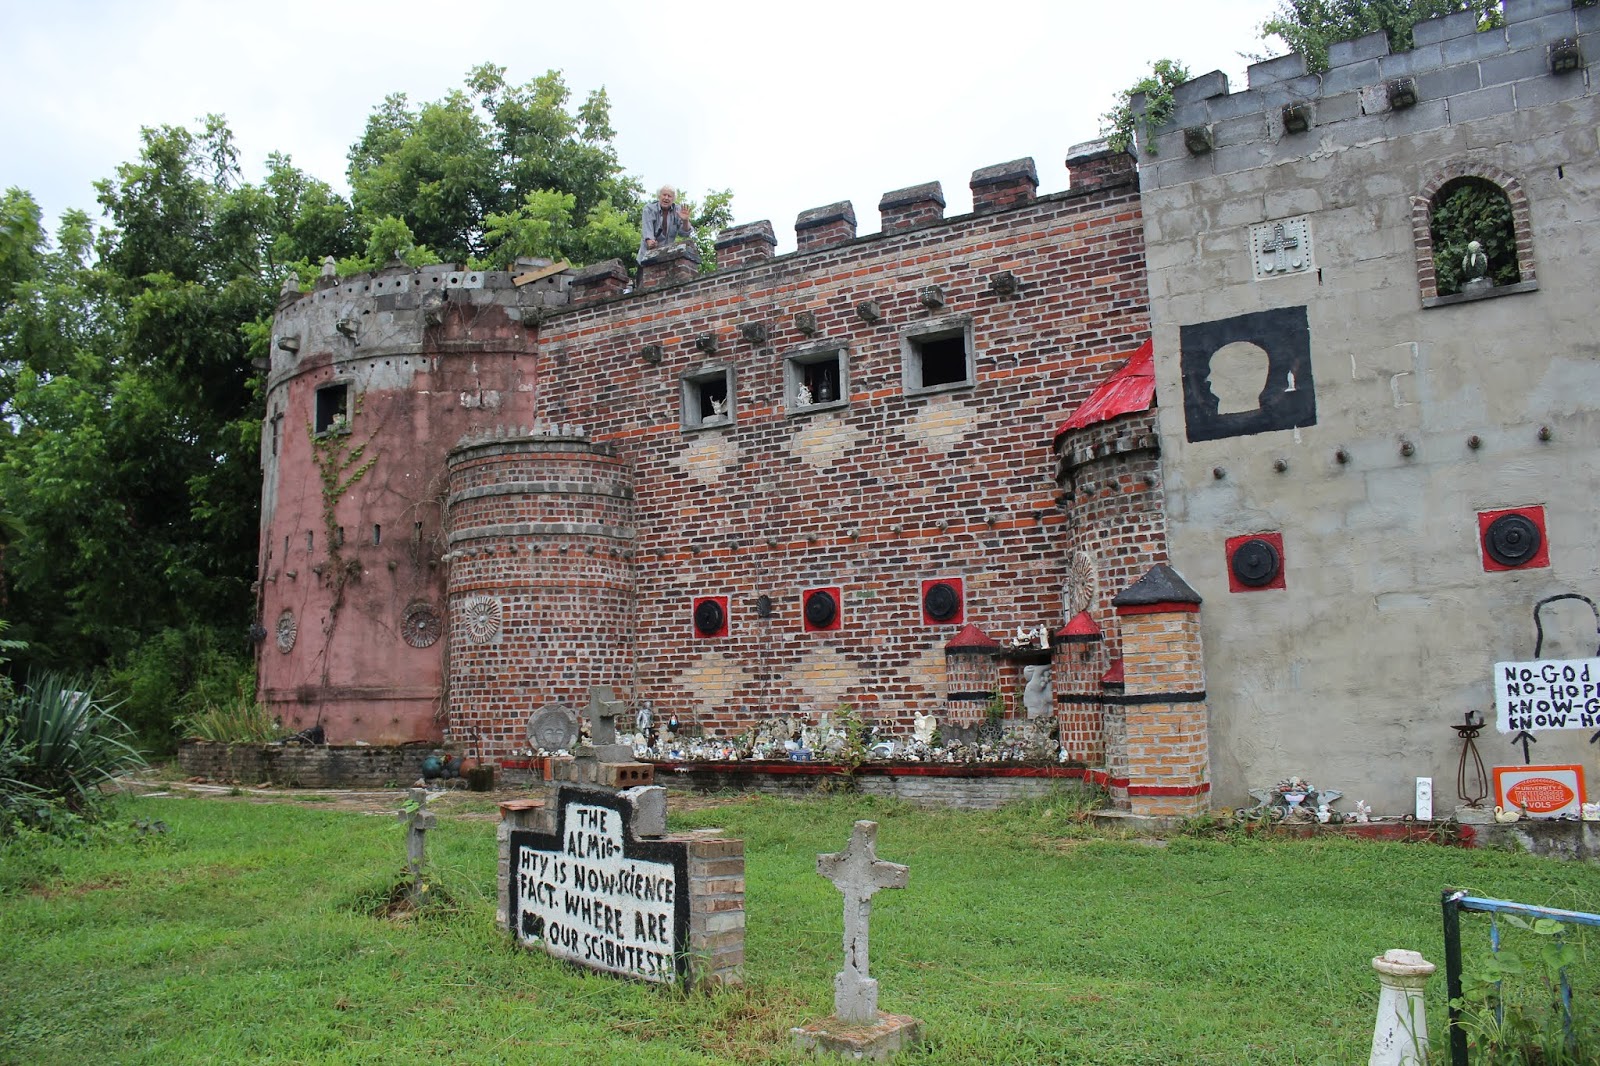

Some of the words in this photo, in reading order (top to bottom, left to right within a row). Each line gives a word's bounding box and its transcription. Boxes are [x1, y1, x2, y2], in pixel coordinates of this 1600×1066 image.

[1507, 682, 1600, 700] NO-HOP
[1515, 790, 1565, 802] TENNESSEE
[577, 809, 607, 833] THE
[521, 851, 548, 878] HTY
[553, 855, 567, 884] iS
[565, 890, 624, 940] WHERE
[634, 910, 669, 945] ARE
[549, 921, 580, 954] OUR
